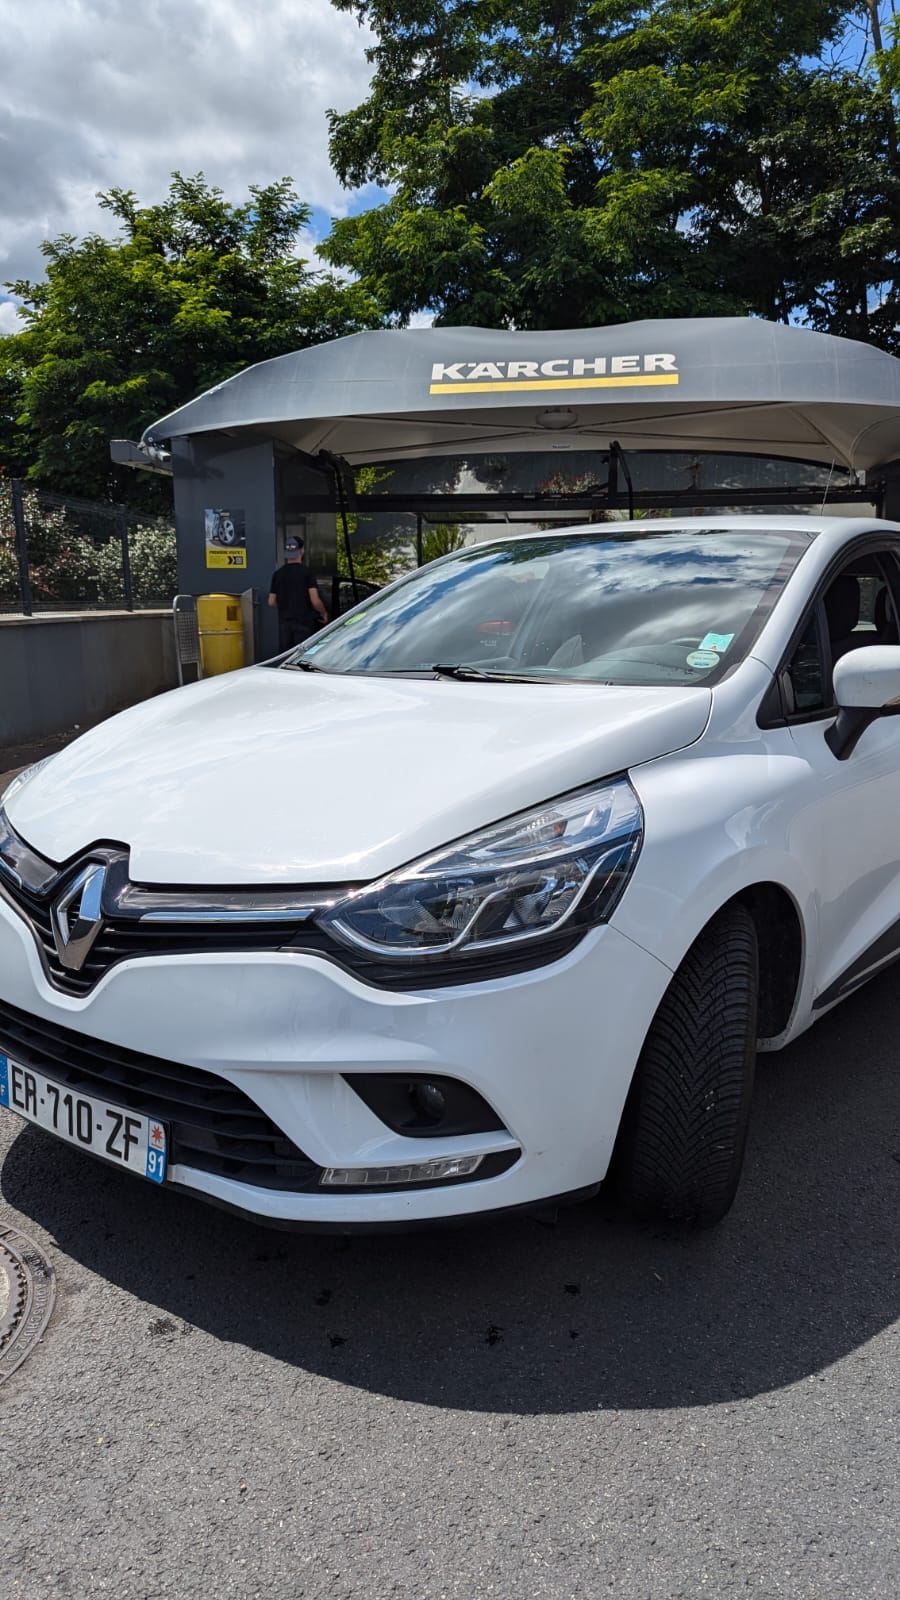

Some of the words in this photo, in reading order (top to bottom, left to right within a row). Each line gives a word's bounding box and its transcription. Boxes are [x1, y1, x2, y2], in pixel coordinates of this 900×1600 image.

[431, 353, 678, 381] KÄRCHER
[11, 1064, 142, 1162] ER-710-ZF
[148, 1150, 164, 1177] 91
